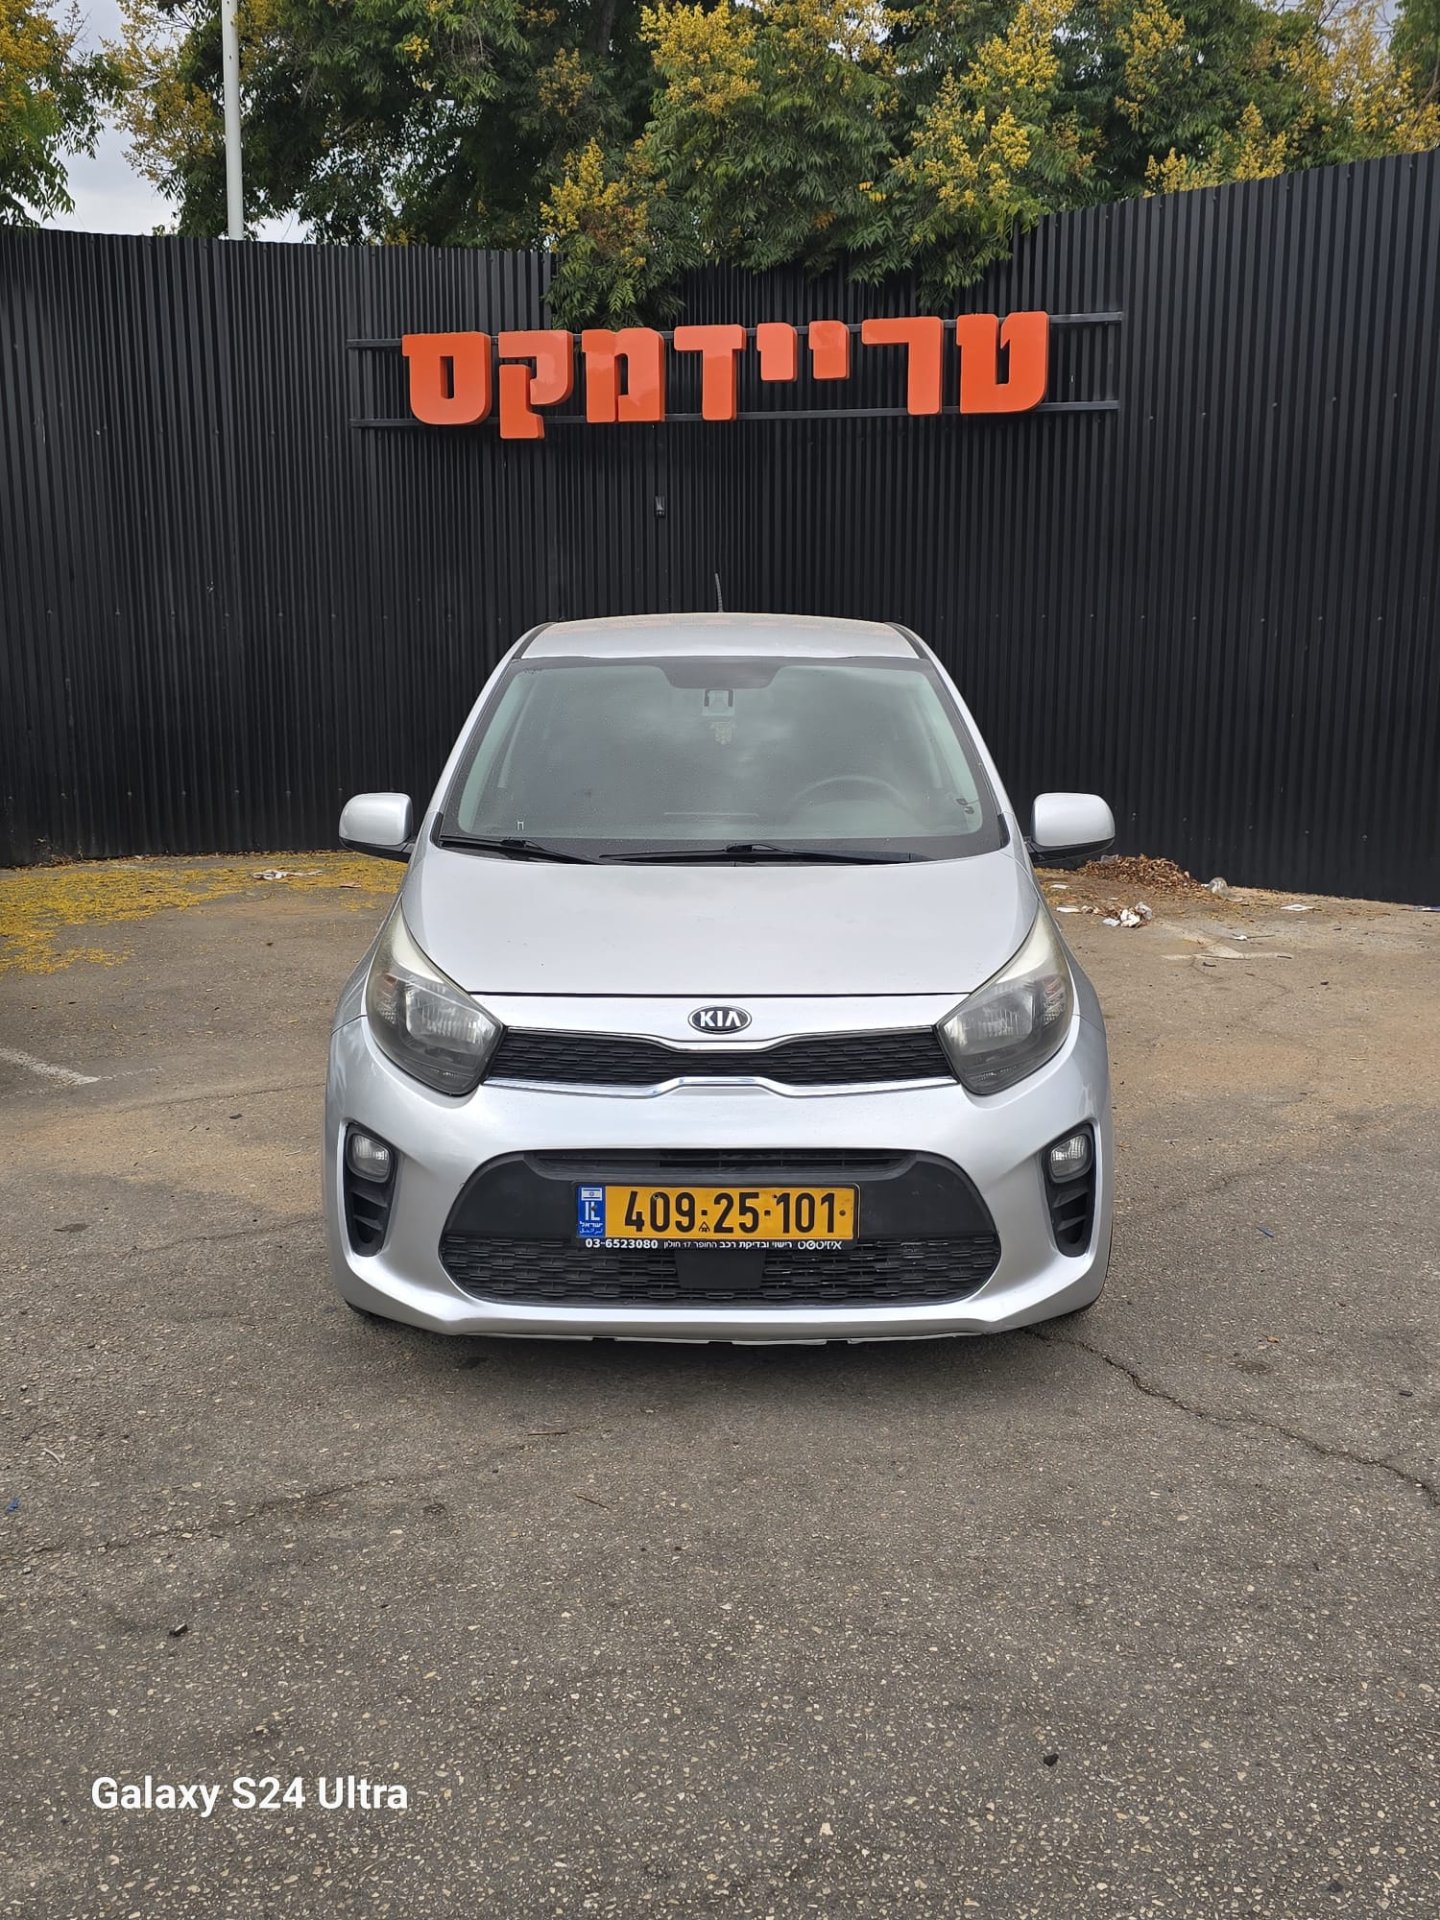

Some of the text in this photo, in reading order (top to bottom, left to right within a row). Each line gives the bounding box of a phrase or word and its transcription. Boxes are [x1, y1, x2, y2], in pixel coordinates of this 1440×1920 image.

[402, 311, 1050, 440] טריידמקס
[700, 1010, 741, 1027] KIA
[585, 1201, 600, 1221] IL
[585, 1238, 658, 1250] 03-6523080
